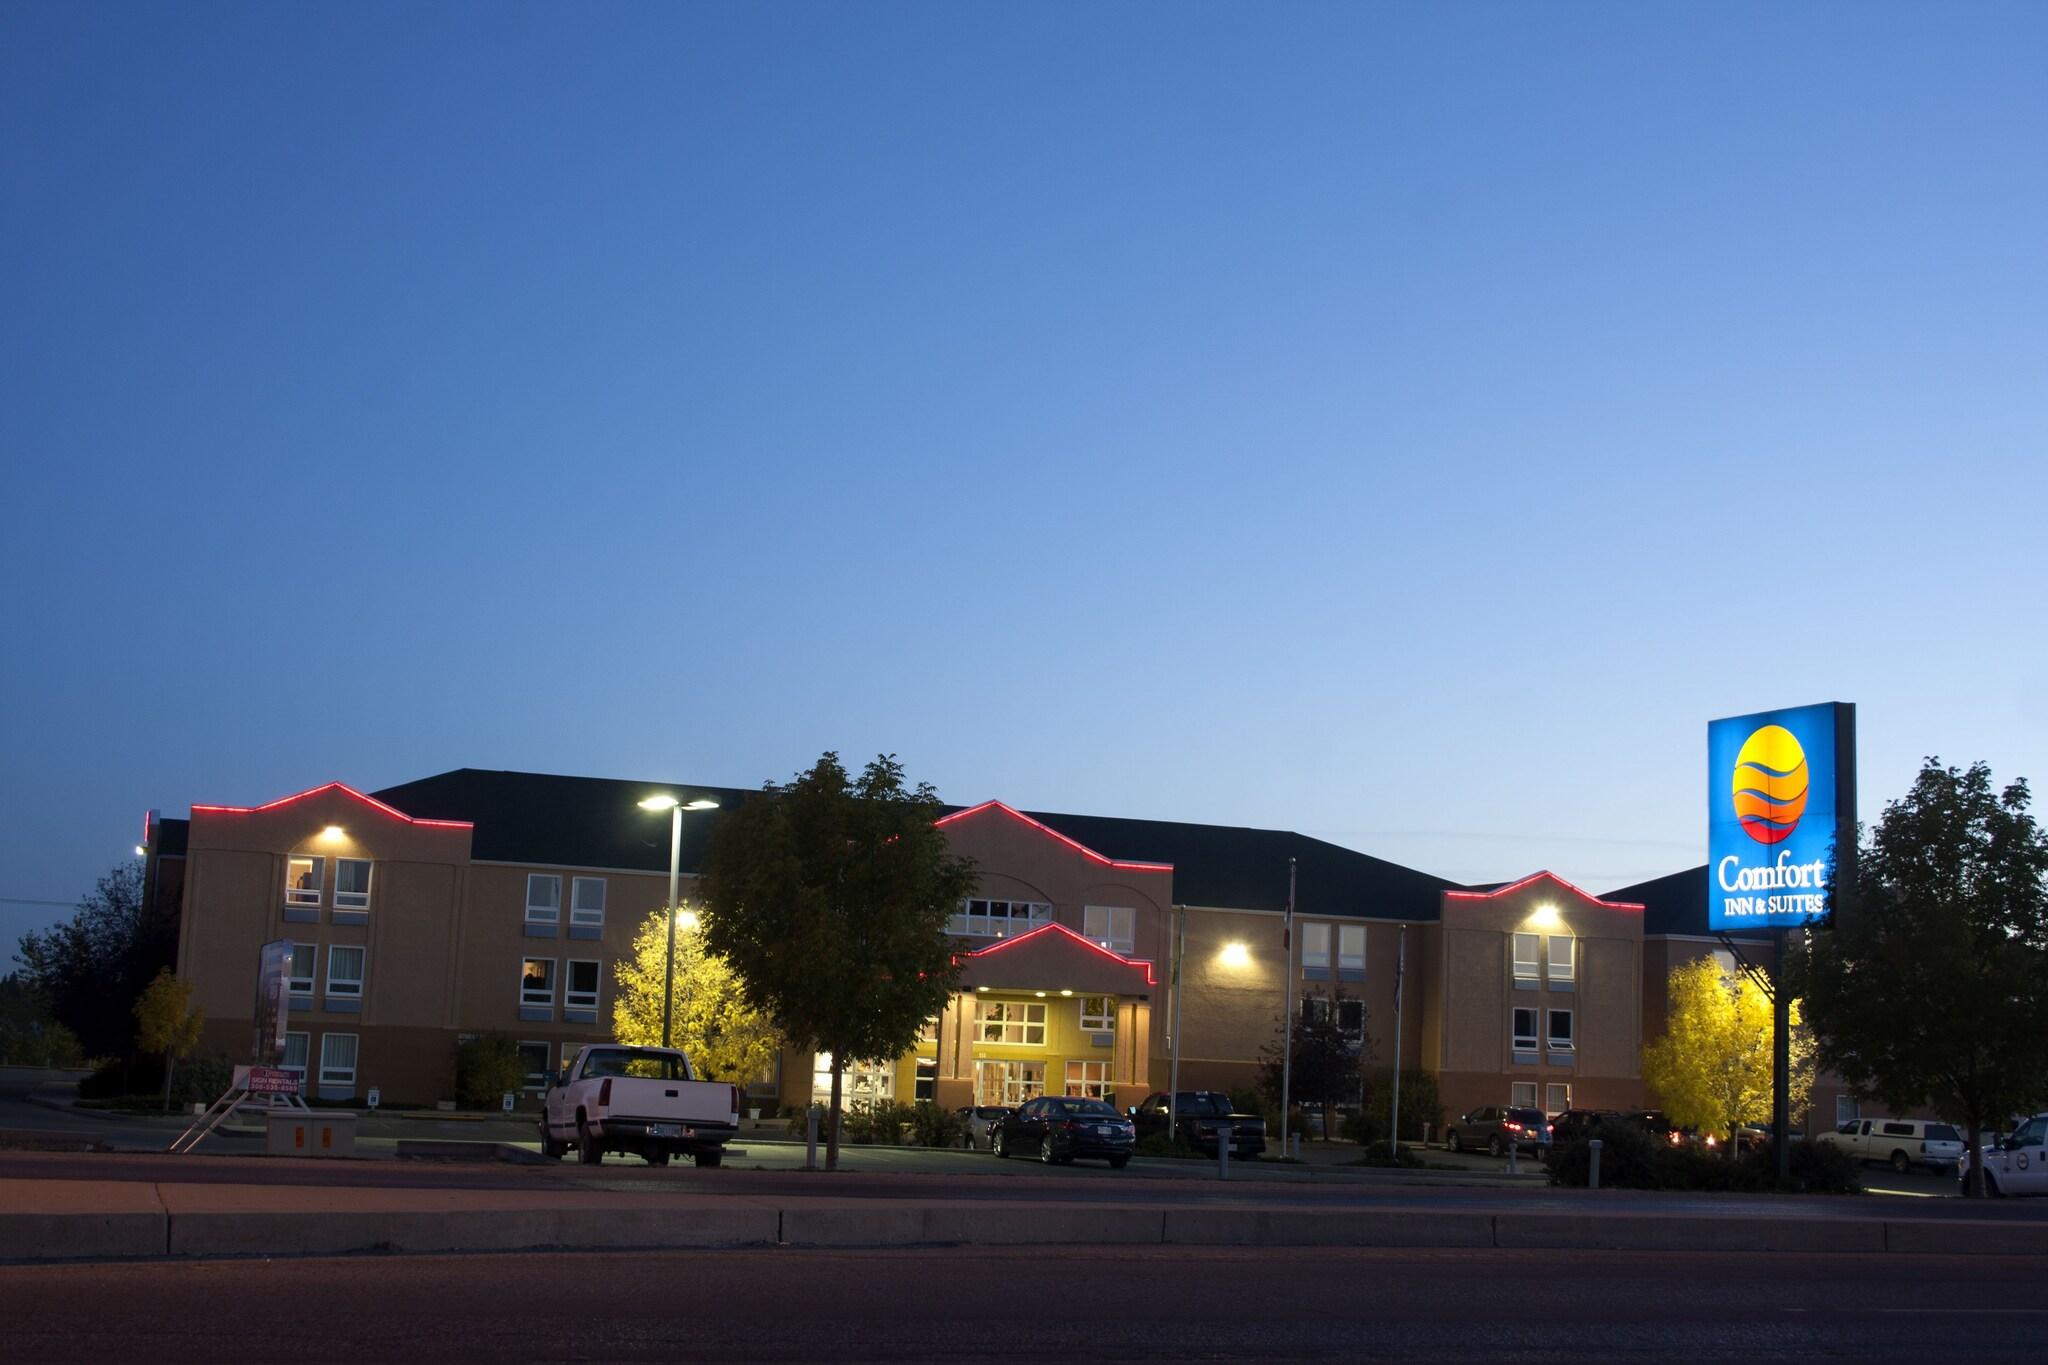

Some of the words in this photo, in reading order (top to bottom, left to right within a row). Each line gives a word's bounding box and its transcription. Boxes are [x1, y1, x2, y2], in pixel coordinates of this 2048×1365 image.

[1718, 849, 1825, 892] Comfort
[1724, 897, 1754, 916] INN
[1755, 897, 1766, 915] &
[1768, 894, 1825, 914] SUITES
